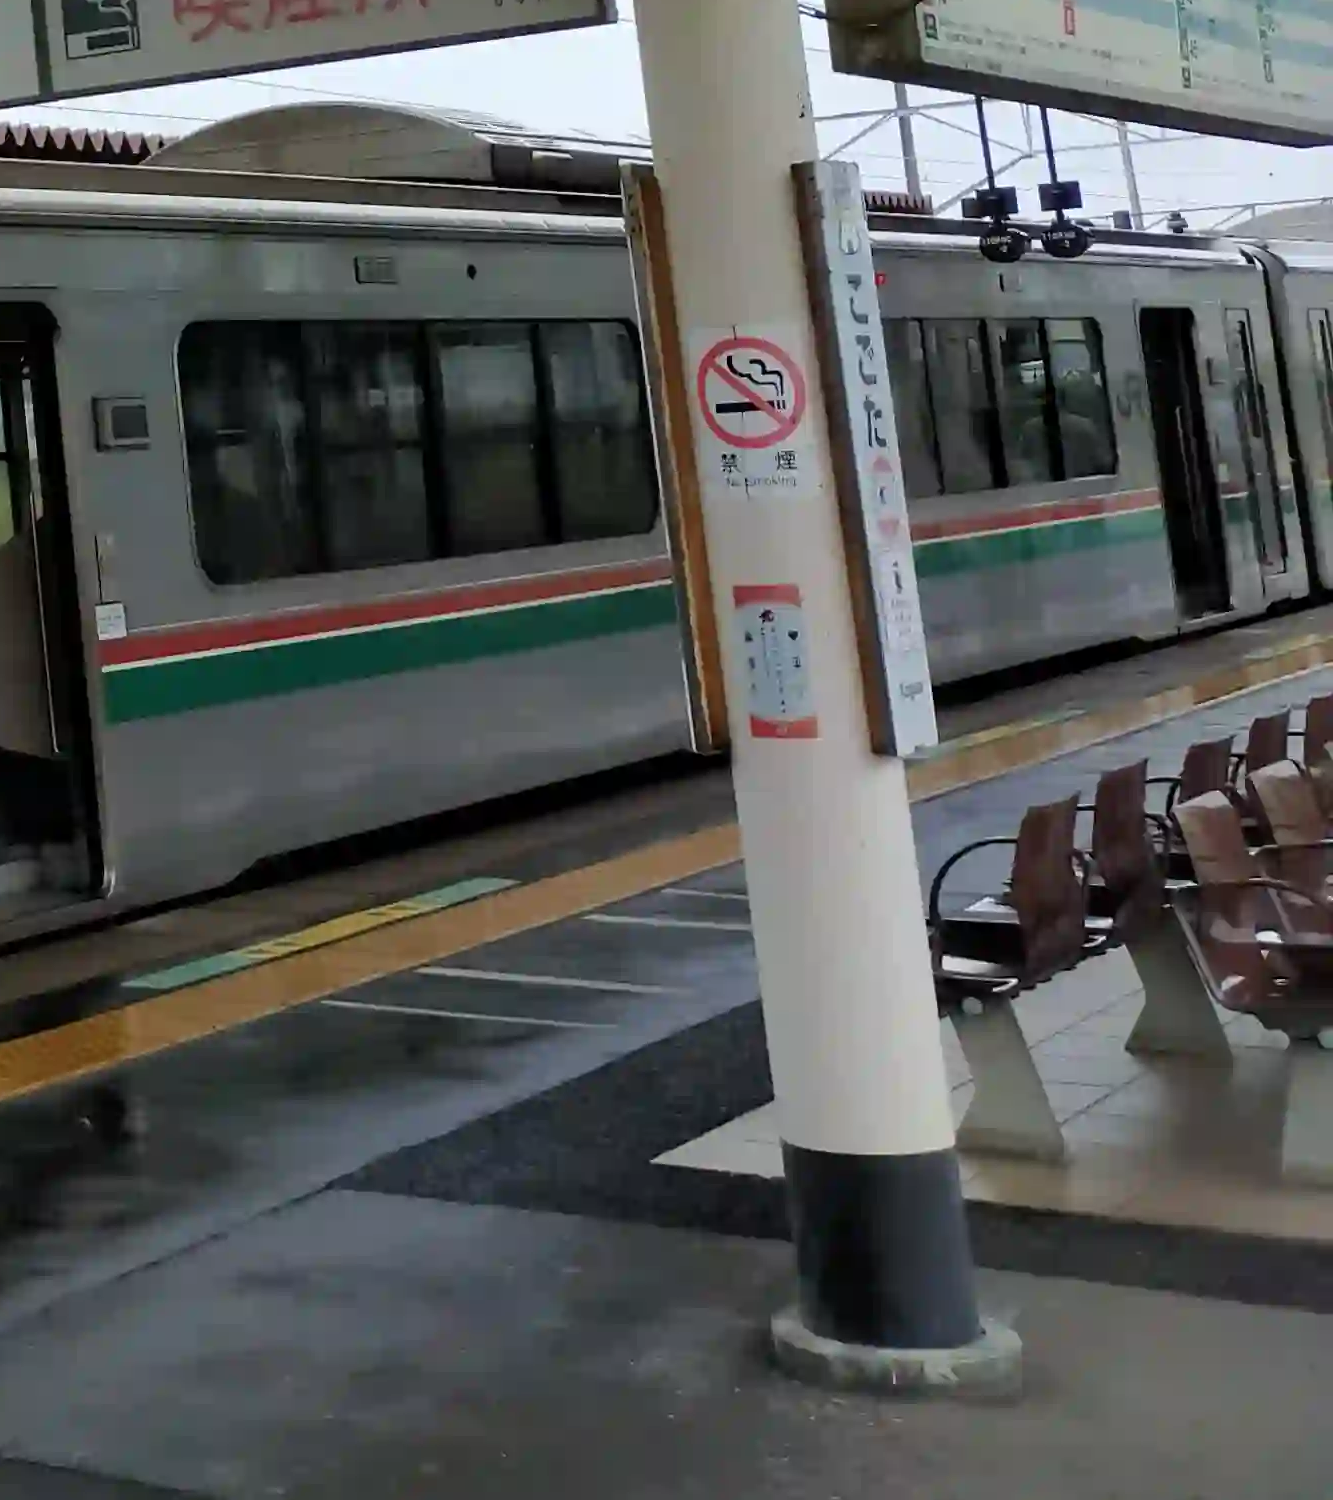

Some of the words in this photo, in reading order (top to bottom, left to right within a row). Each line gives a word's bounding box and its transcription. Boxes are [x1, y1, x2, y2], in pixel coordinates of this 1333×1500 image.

[844, 273, 888, 449] こごた
[720, 450, 798, 474] 禁煙
